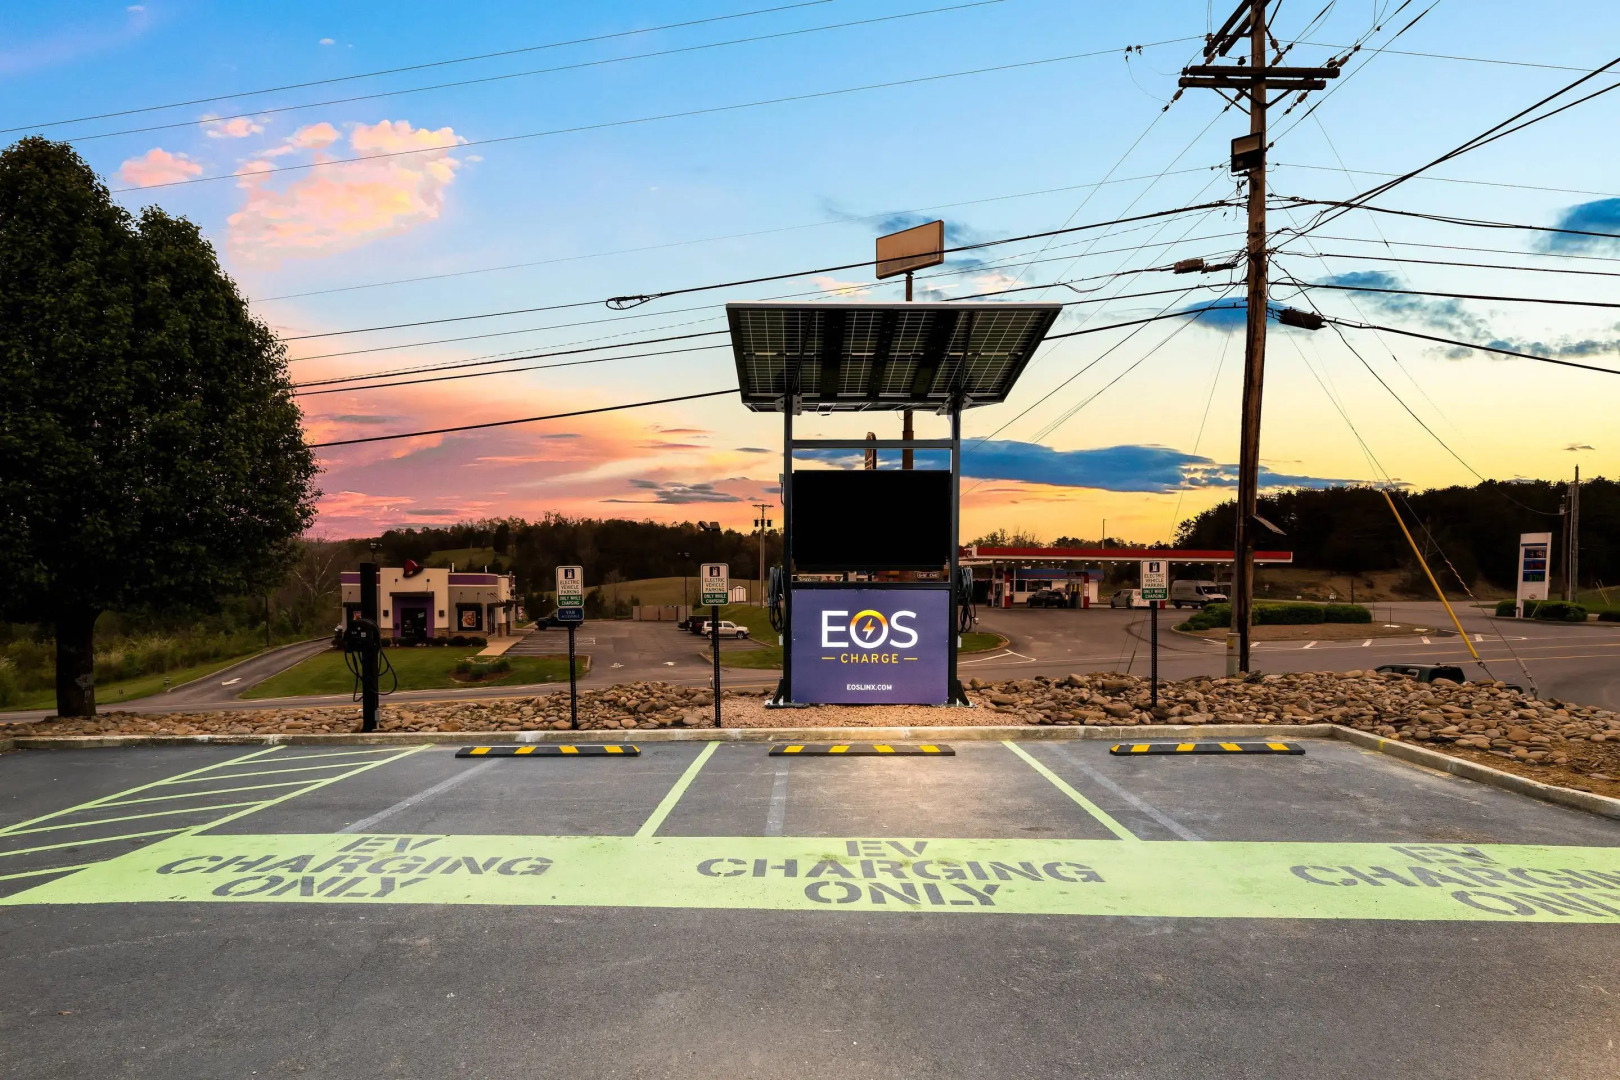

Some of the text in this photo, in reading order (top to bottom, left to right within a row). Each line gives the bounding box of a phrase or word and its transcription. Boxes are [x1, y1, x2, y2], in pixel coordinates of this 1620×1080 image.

[822, 609, 918, 648] EOS
[840, 654, 898, 664] CHARGE
[338, 836, 443, 853] EV
[846, 840, 928, 857] EV
[1389, 846, 1500, 864] EV
[156, 854, 554, 876] CHARGING
[696, 858, 1106, 883] CHARGING
[212, 876, 428, 898] ONLY
[804, 880, 1000, 906] ONLY
